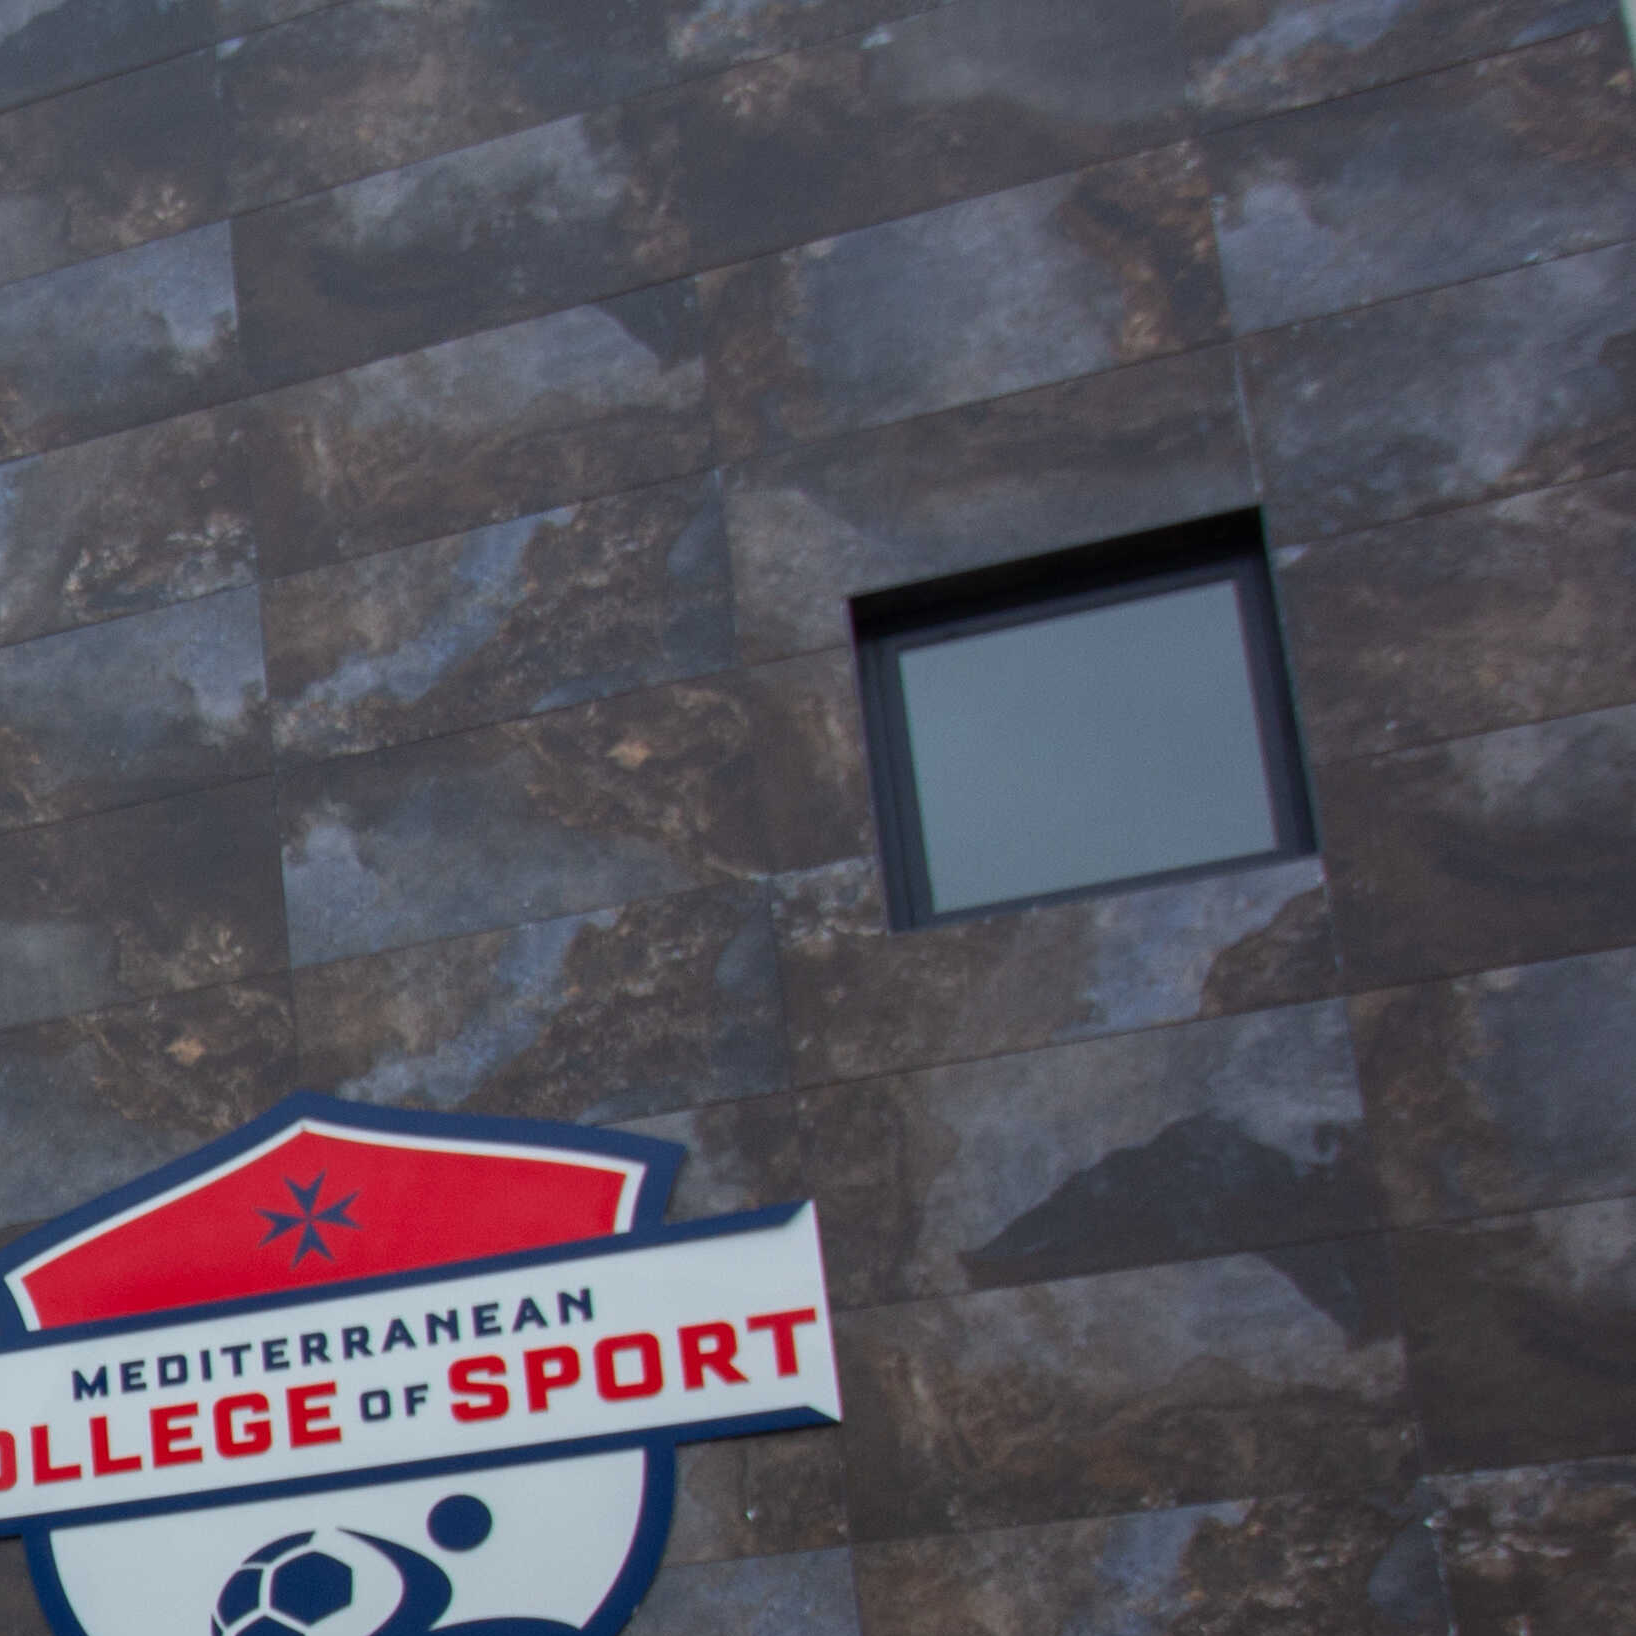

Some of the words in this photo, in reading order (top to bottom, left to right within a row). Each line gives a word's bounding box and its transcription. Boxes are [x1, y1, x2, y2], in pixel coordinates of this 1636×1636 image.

[72, 1287, 594, 1402] MEDITERRANEAN
[359, 1383, 429, 1426] OF
[447, 1307, 819, 1425] SPORT
